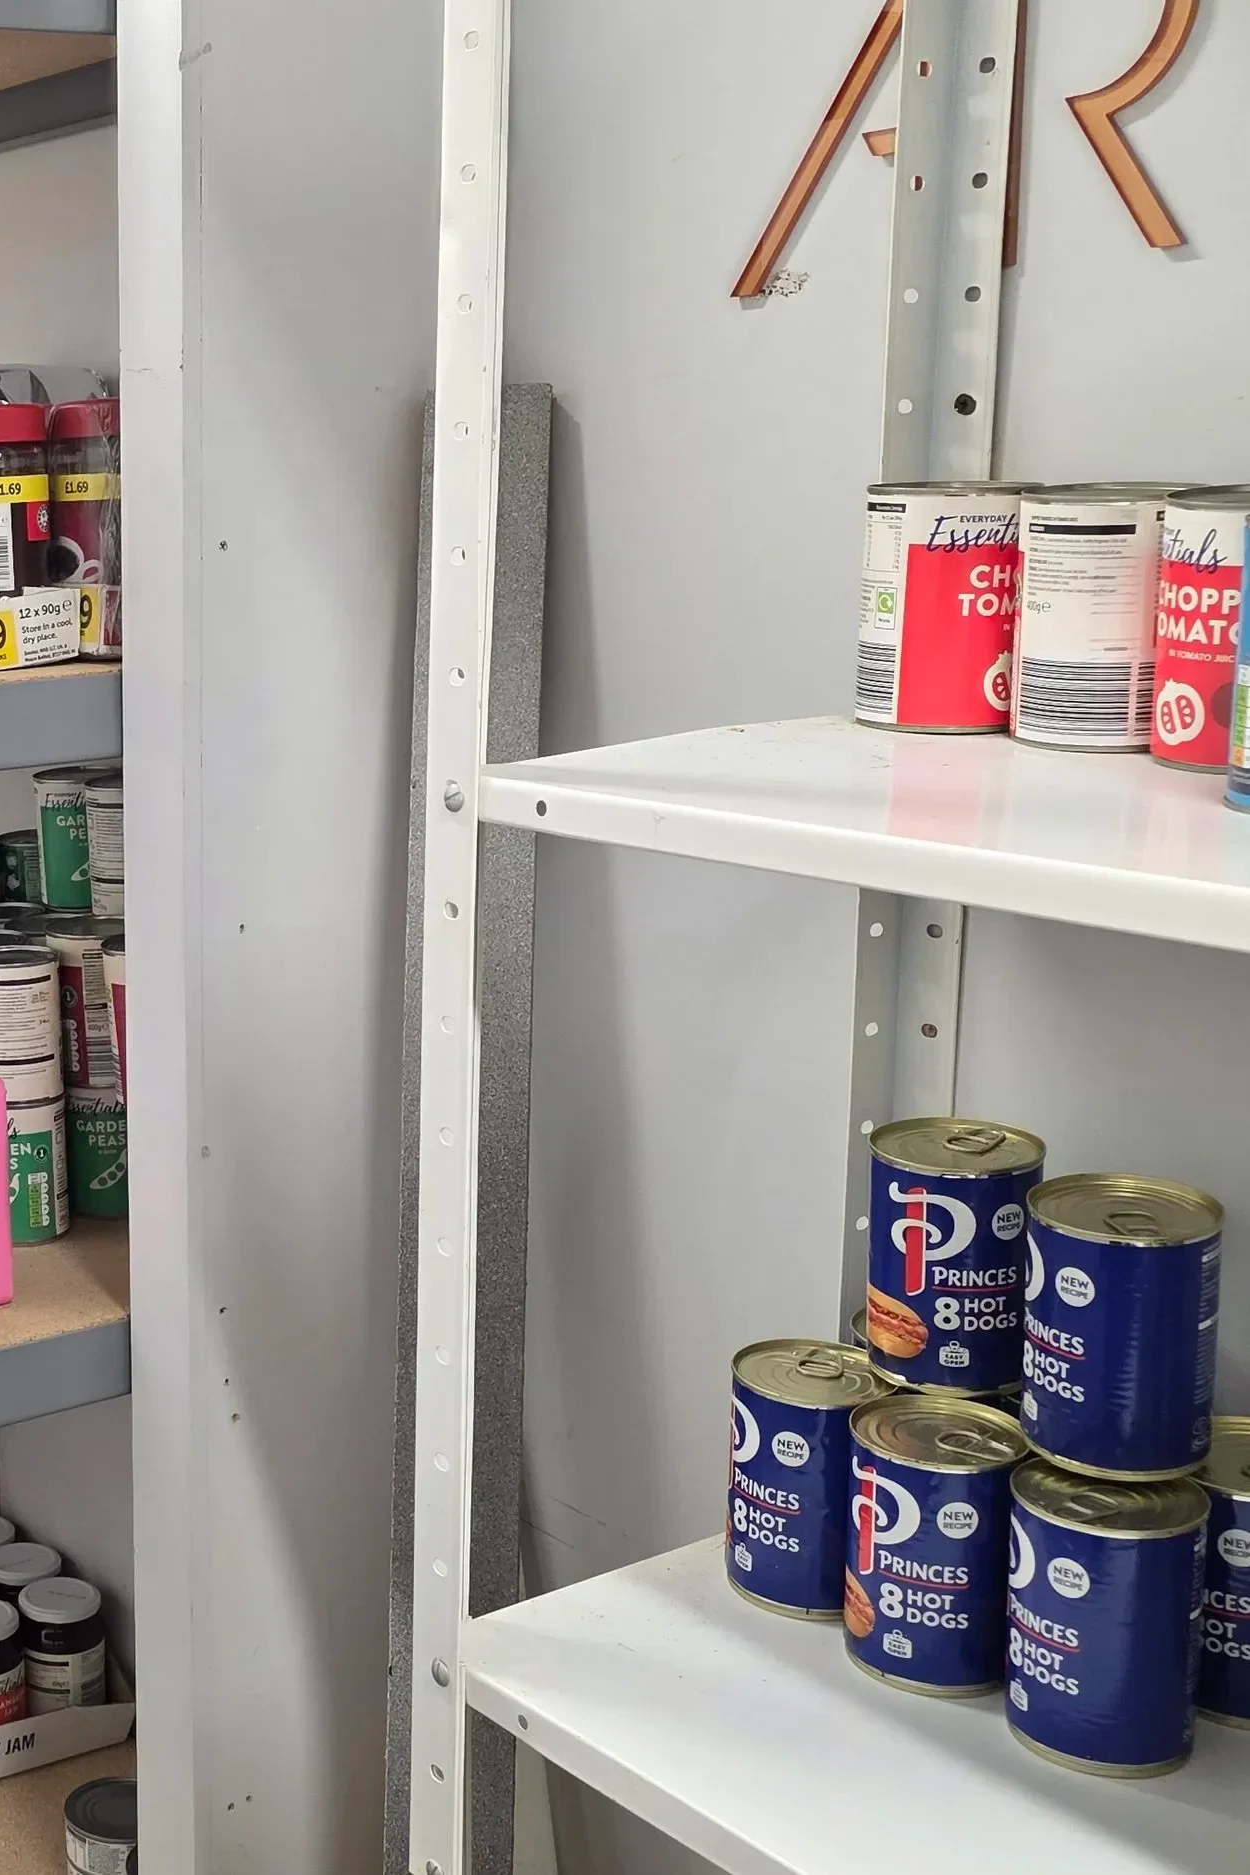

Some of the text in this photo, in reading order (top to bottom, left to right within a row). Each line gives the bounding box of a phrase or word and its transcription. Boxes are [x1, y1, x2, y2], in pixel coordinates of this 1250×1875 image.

[65, 481, 89, 494] £1.69
[959, 515, 1008, 523] EVERYDAY
[19, 608, 31, 619] 12
[41, 603, 61, 616] 90g
[22, 624, 41, 634] Store
[23, 632, 57, 645] dry place.
[1177, 649, 1212, 662] TOMATO
[89, 1133, 126, 1147] PEAS
[996, 1210, 1021, 1224] NEW
[996, 1223, 1021, 1234] RECIPE
[931, 1266, 1017, 1288] PRINCES
[1061, 1274, 1089, 1290] NEW
[1061, 1286, 1088, 1300] RECIPE
[933, 1297, 1007, 1331] 8 HOT
[963, 1312, 1017, 1332] DOGS
[1023, 1340, 1070, 1379] 8 HOT
[1034, 1367, 1085, 1403] DOGS
[777, 1439, 805, 1452] NEW
[777, 1449, 804, 1460] RECIPE
[734, 1466, 800, 1511] PRINCES
[734, 1497, 786, 1532] 8 HOT
[944, 1511, 975, 1521] NEW
[943, 1521, 973, 1530] RECIPE
[748, 1526, 800, 1553] DOGS
[878, 1550, 969, 1584] PRINCES
[1054, 1565, 1084, 1582] NEW
[1054, 1577, 1083, 1591] RECIPE
[880, 1582, 954, 1618] 8 HOT
[906, 1611, 969, 1629] DOGS
[1009, 1627, 1063, 1671] 8 HOT
[1023, 1657, 1079, 1696] DOGS
[5, 1732, 36, 1756] JAM
